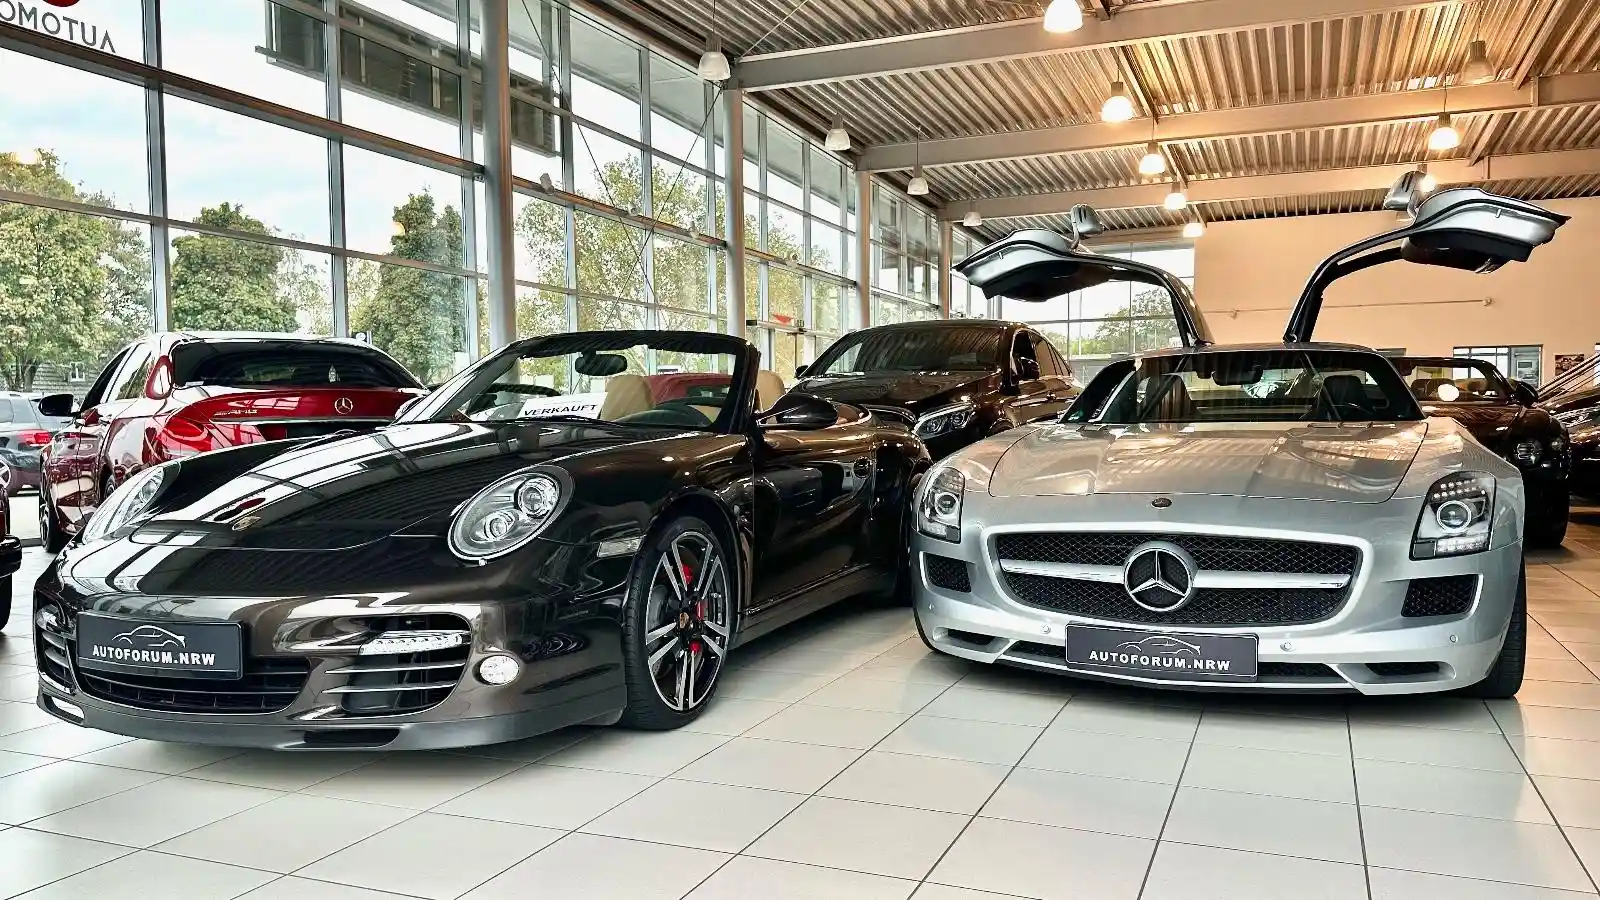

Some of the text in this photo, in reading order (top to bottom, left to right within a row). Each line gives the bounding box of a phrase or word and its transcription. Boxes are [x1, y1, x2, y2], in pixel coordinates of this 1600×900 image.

[524, 404, 598, 416] VERKAUFT
[92, 644, 216, 666] AUTOFORUM.NRW
[1089, 650, 1231, 671] AUTOFORUM.NRW
